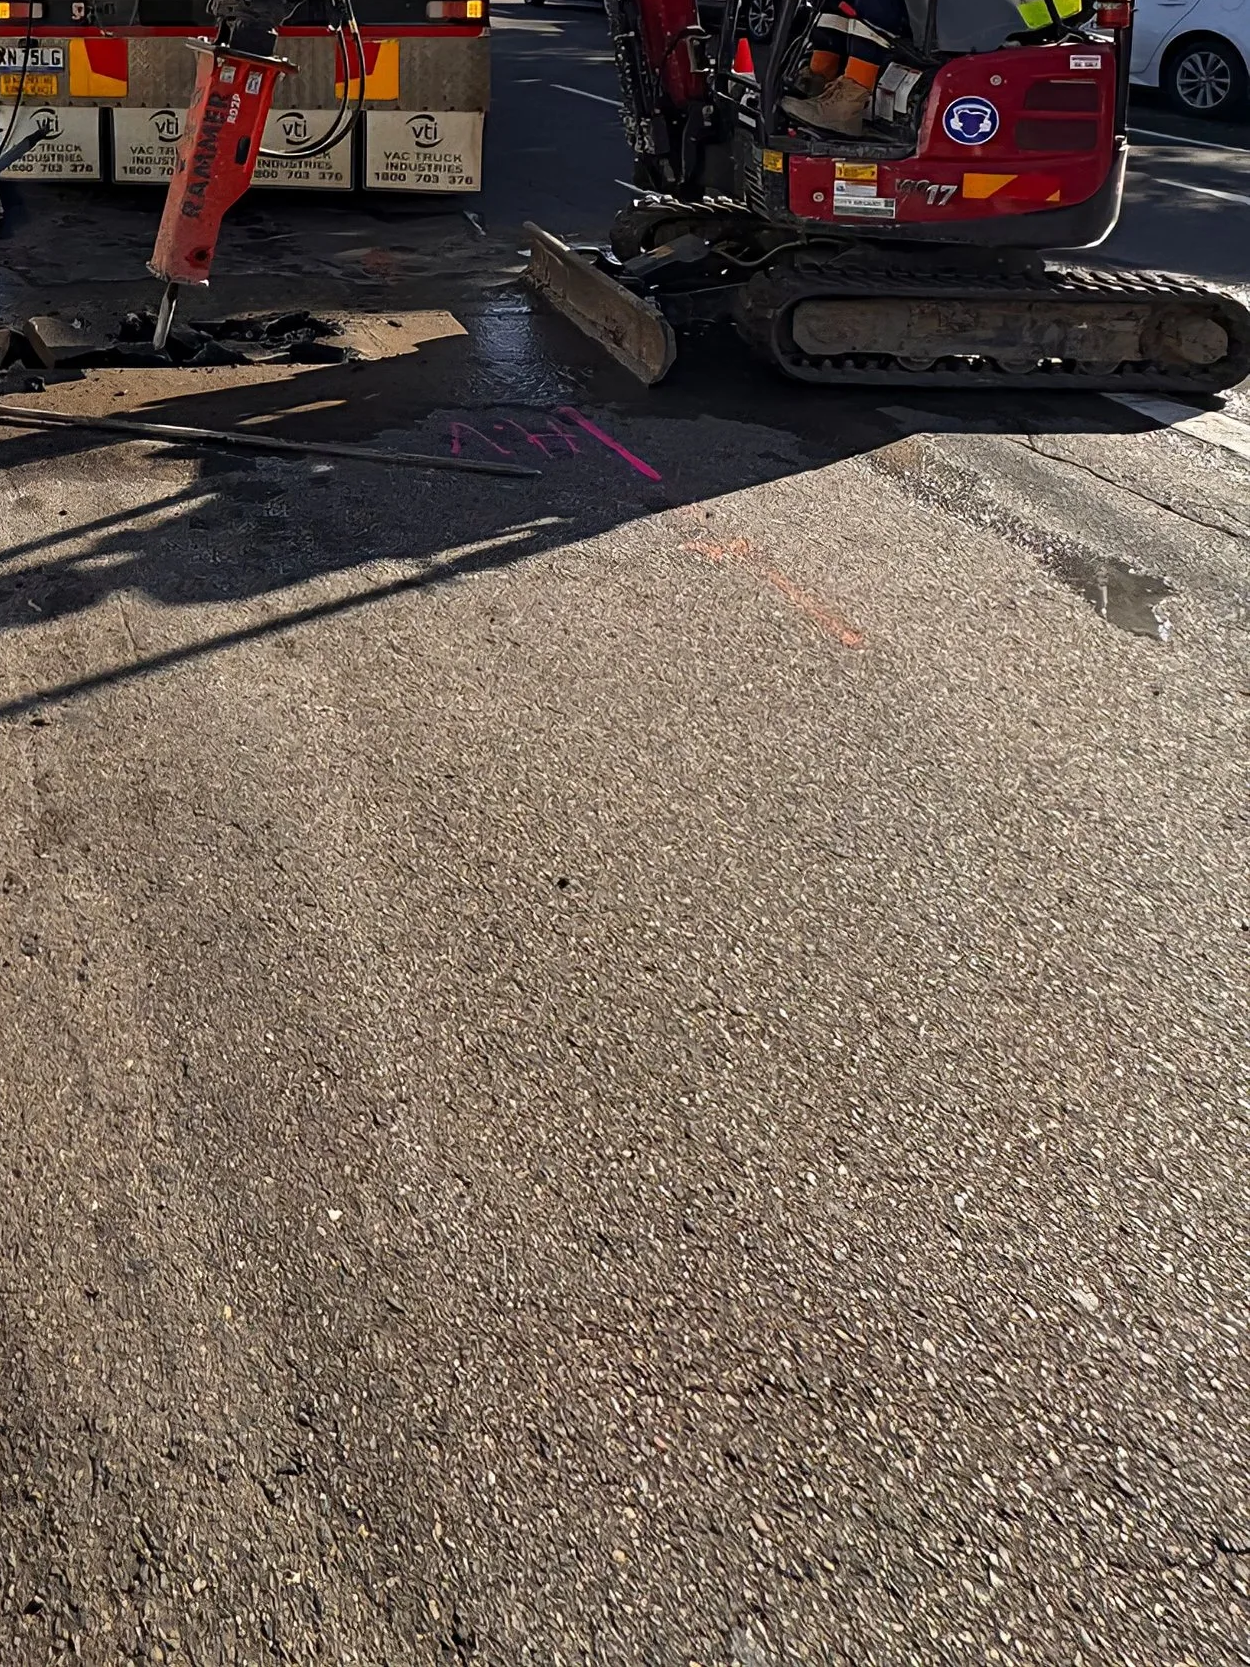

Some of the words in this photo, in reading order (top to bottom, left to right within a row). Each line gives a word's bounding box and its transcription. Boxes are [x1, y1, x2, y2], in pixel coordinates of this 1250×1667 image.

[155, 115, 179, 135] vti
[282, 122, 307, 138] vti
[411, 122, 438, 140] vti
[39, 143, 82, 152] TRUCK
[130, 146, 154, 155] VAC
[18, 153, 84, 162] NDUSTRIES
[132, 156, 175, 165] INDUST
[181, 91, 229, 219] RAMMER
[384, 151, 411, 161] VAC
[415, 152, 462, 162] TRUCK
[257, 159, 333, 170] INDUSTRIES
[385, 162, 463, 173] INDUSTRIES
[122, 166, 151, 175] 1800
[159, 166, 174, 175] 70
[254, 169, 278, 179] 800
[287, 170, 310, 179] 703
[375, 172, 407, 182] 1800
[415, 174, 439, 183] 703
